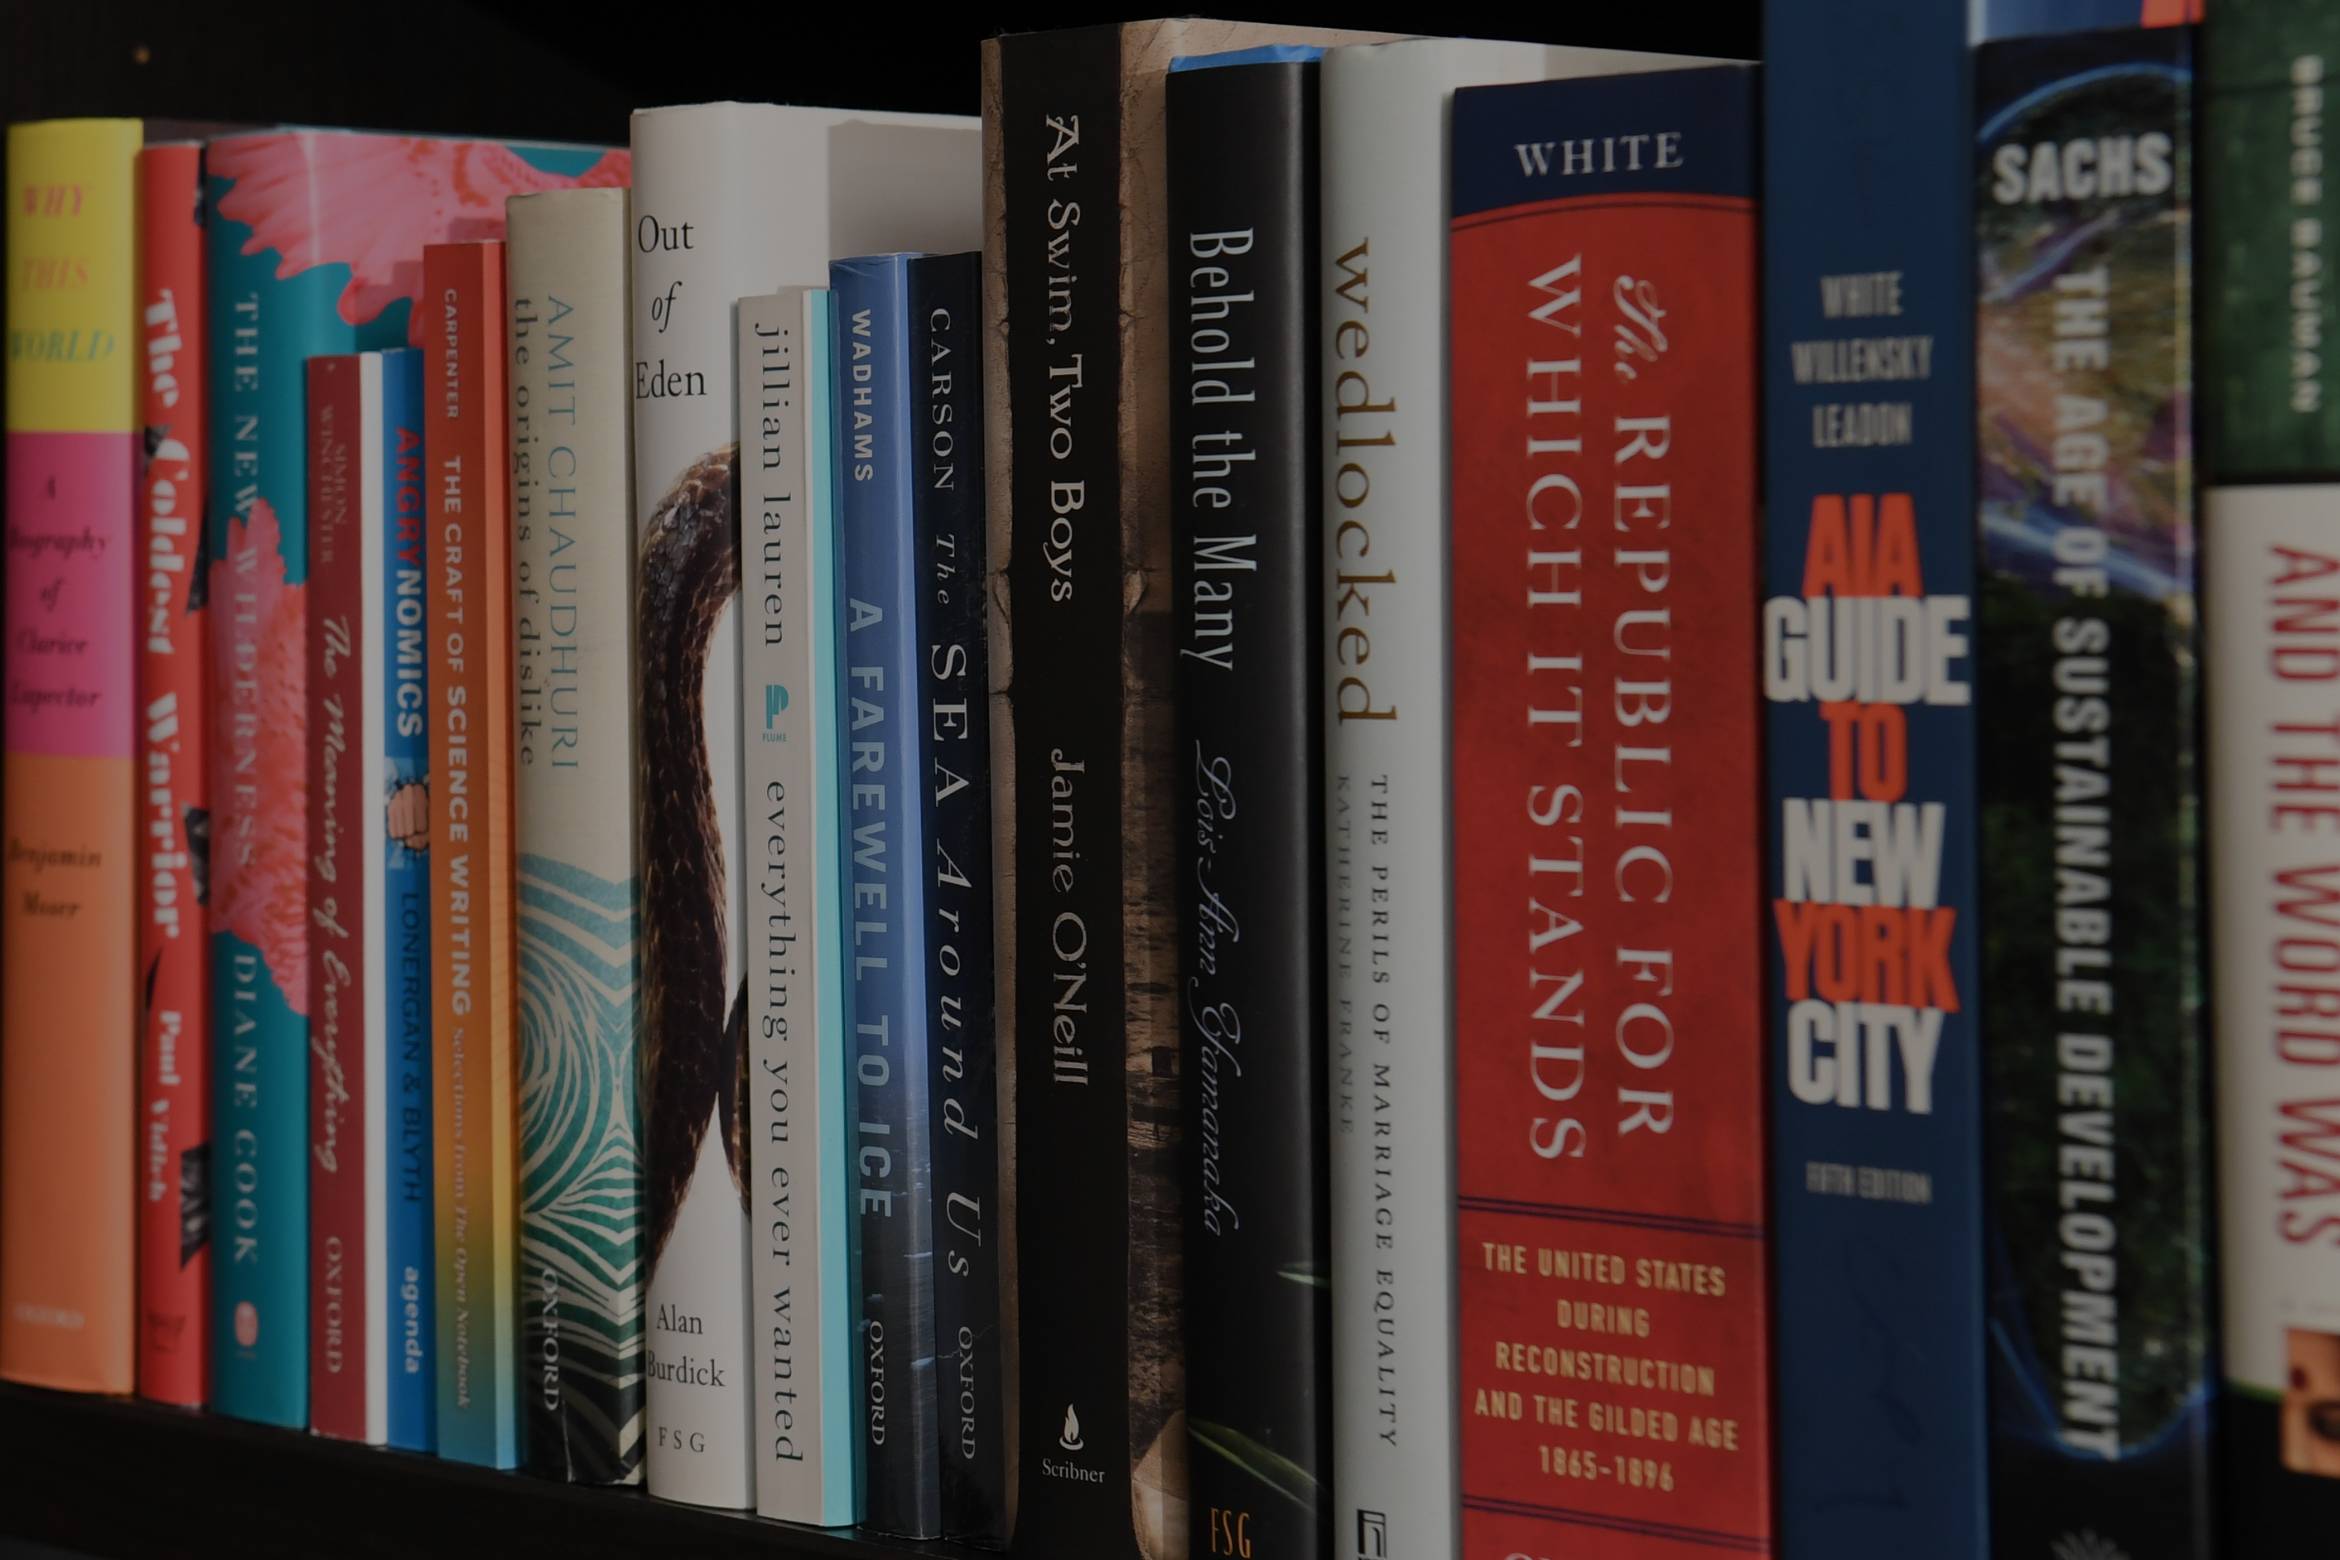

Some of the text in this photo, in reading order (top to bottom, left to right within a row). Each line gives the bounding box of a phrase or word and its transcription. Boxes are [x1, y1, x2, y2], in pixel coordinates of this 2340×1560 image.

[22, 184, 84, 218] WHY
[1512, 131, 1684, 177] WHITE
[1993, 131, 2174, 205] SACHS
[637, 215, 694, 253] Out
[1820, 270, 1904, 319] WHITE
[8, 329, 115, 362] WORLD
[444, 288, 461, 419] CARPENTER
[651, 281, 683, 333] of
[1042, 113, 1087, 604] At Swim, Two Boys
[1790, 335, 1934, 384] WILLENSKY
[635, 359, 707, 399] Eden
[851, 307, 874, 482] WADHAMS
[929, 307, 956, 491] CARSON
[1812, 402, 1913, 448] LEADON
[755, 322, 793, 648] jillian lauren
[1179, 226, 1258, 671] Behold the Many
[1335, 236, 1398, 727] wedlocked
[233, 291, 259, 866] THE NEW WILDERNESS
[395, 425, 424, 739] ANGRYNOMICS
[514, 297, 542, 767] the origins of dislike
[548, 295, 579, 768] AMIT CHAUDHURI
[1801, 492, 1924, 598] AIA
[144, 288, 191, 939] The Coldest Warrior
[1762, 594, 1972, 706] GUIDE
[443, 455, 472, 1016] THE CRAFT OF SCIENCE WRITING
[762, 732, 788, 744] PLUME
[1525, 250, 1588, 1160] WHICH IT STANDS
[1613, 273, 1675, 1137] The REPUBLIC FOR
[1818, 700, 1909, 804] TO
[1049, 747, 1086, 895] Jamie
[1780, 797, 1946, 909] NEW
[2052, 266, 2121, 1462] THE AGE OF SUSTAINABLE DEVELOPMENT
[311, 614, 352, 1174] The Meaning of Everything
[849, 597, 893, 1218] A FAREWELL TO ICE
[930, 533, 982, 1277] The SEA Around Us
[1336, 774, 1354, 1135] KATHERINE FRANKE
[1773, 897, 1961, 1014] YORK
[2272, 546, 2340, 1245] AND THE WORD WAS
[158, 1010, 183, 1086] Paul
[401, 892, 427, 1202] LONERGAN & BLYTH
[1185, 738, 1243, 1238] Lois-Ann Yamanaka
[234, 954, 259, 1266] DIANE COOK
[1370, 773, 1399, 1448] THE PERILS OF MARRIAGE EQUALITY
[1786, 997, 1945, 1116] CITY
[760, 780, 804, 1462] everything you ever wanted
[1855, 1165, 1934, 1206] EDITION
[325, 1236, 344, 1374] OXFORD
[401, 1265, 424, 1375] agenda
[453, 1247, 468, 1303] Open
[656, 1303, 704, 1335] Alan
[1481, 1241, 1727, 1297] THE UNITED STATES
[1556, 1298, 1650, 1338] DURING
[455, 1306, 472, 1409] Notebook
[541, 1268, 560, 1412] OXFORD
[647, 1350, 726, 1388] Burdick
[868, 1319, 887, 1447] OXFORD
[957, 1325, 976, 1461] OXFORD
[1494, 1340, 1716, 1397] RECONSTRUCTION
[1041, 1457, 1106, 1484] Scribner
[1474, 1388, 1740, 1452] AND THE GILDED AGE
[1208, 1504, 1254, 1560] FSG
